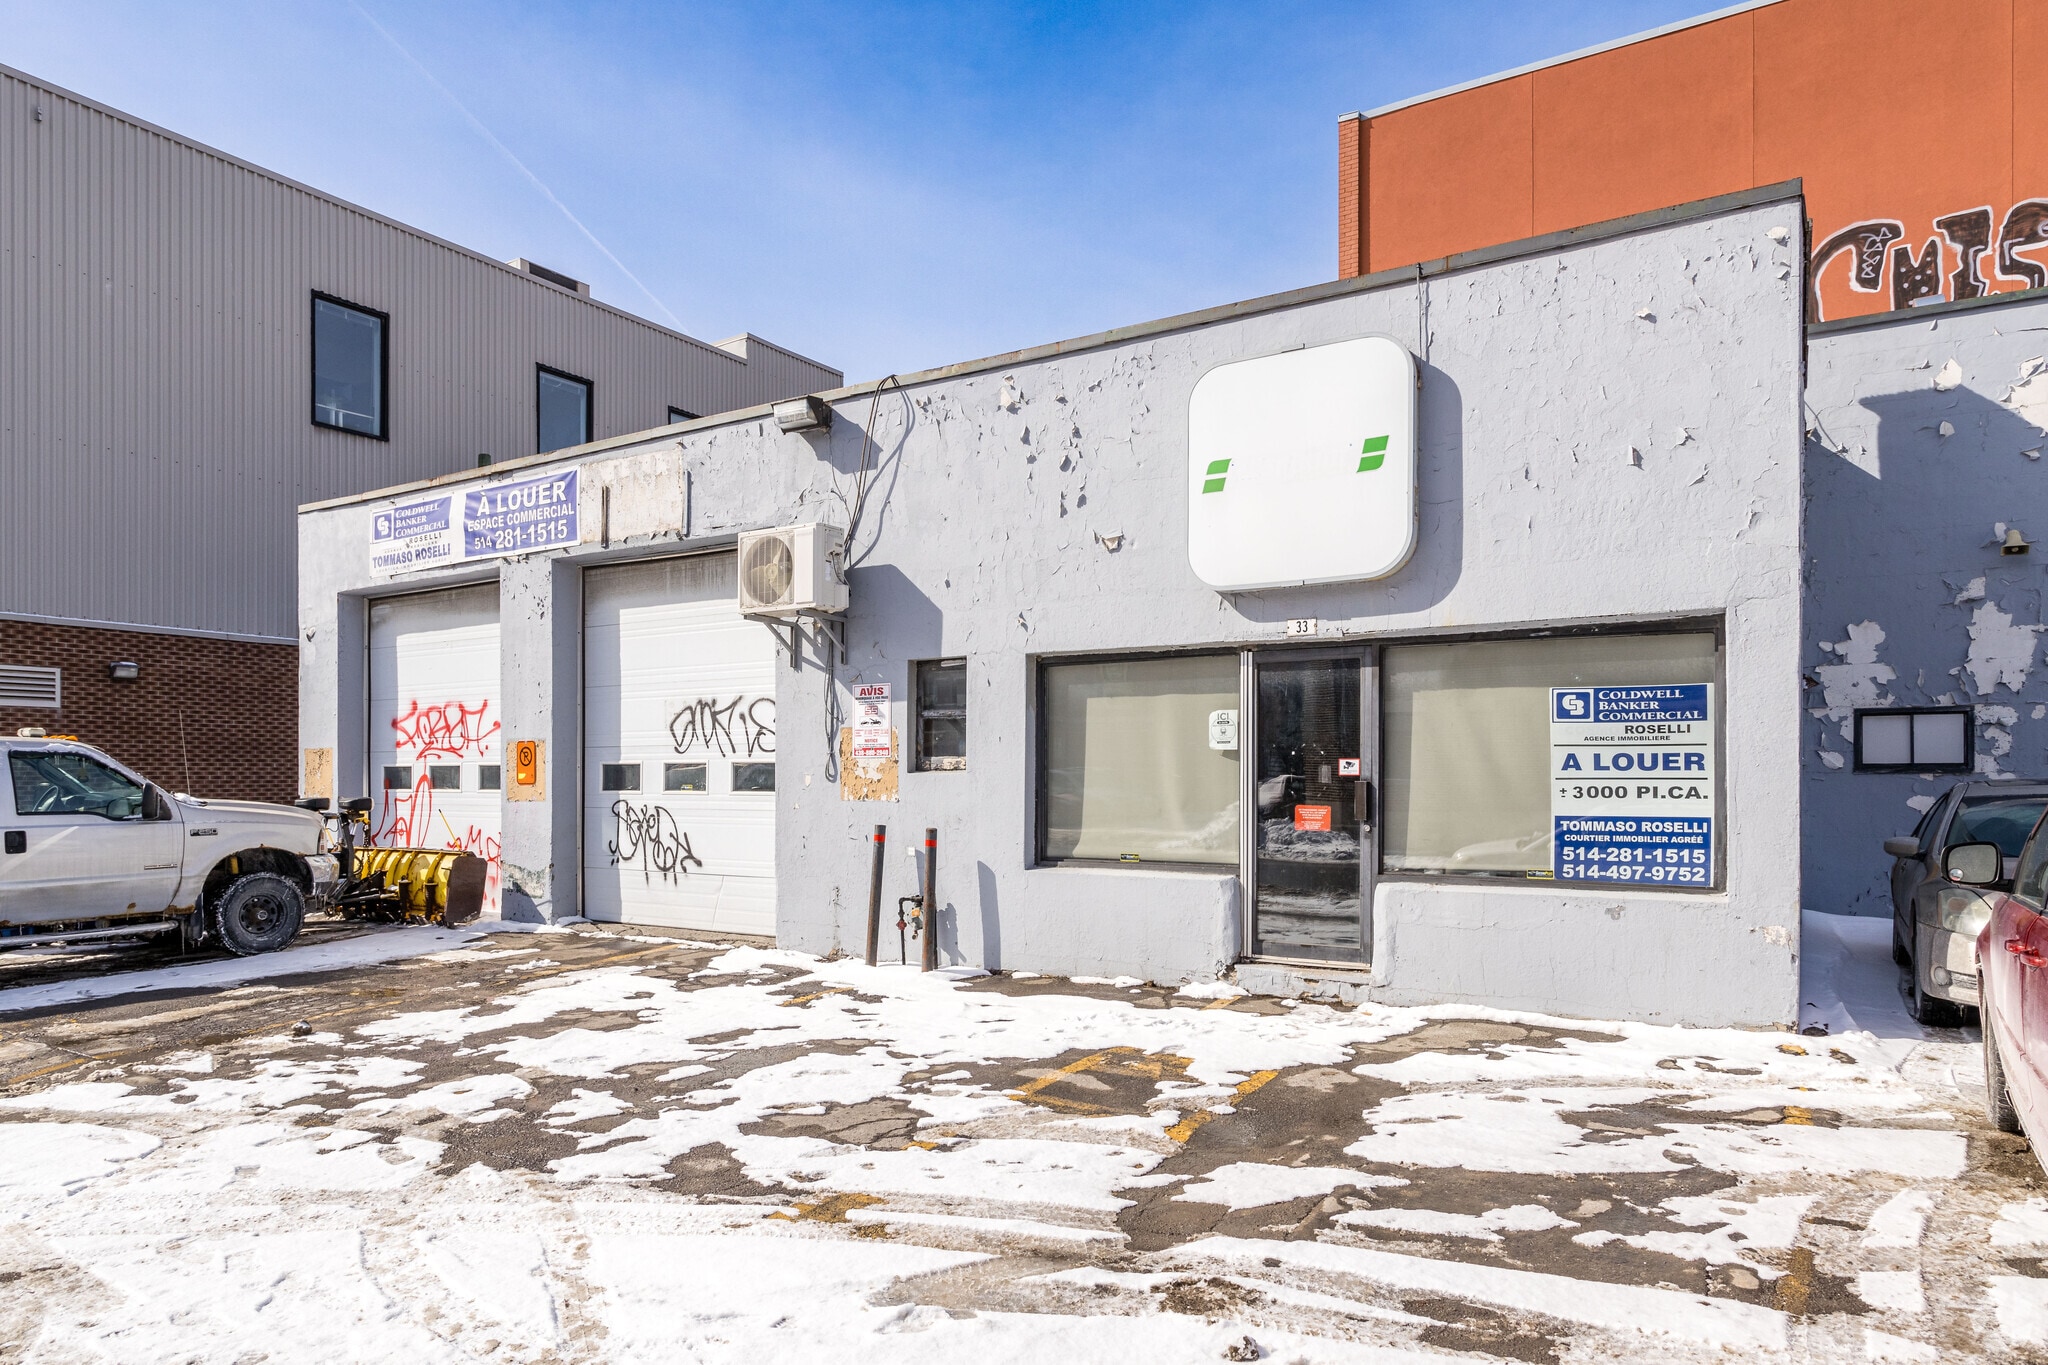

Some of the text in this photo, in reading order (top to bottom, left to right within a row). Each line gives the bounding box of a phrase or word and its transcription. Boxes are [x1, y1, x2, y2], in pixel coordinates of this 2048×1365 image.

[476, 480, 567, 516] À LOUER
[396, 504, 440, 518] COLDWELL
[468, 502, 575, 532] ESPACE COMMERCIAL
[396, 515, 427, 528] BANKER
[396, 520, 447, 538] COMMERCIAL
[474, 520, 568, 550] 514 281-1515
[409, 532, 442, 544] ROSELLI
[372, 551, 413, 568] TOMMASO
[415, 543, 451, 561] ROSELLI
[1296, 620, 1308, 633] 33
[860, 687, 884, 696] AVIS
[1598, 689, 1684, 700] COLDWELL
[1598, 701, 1660, 711] BANKER
[1598, 710, 1703, 721] COMMERCIAL
[1624, 724, 1691, 734] ROSELLI
[1560, 752, 1706, 772] A LOUER
[1572, 785, 1628, 799] 3000
[1636, 785, 1709, 800] PI.CA.
[1560, 820, 1708, 833] TOMMASO ROSELLI
[1564, 834, 1611, 842] COURTIER
[1612, 835, 1669, 843] IMMOBILIER
[1562, 846, 1706, 864] 514-281-1515
[1562, 864, 1706, 882] 514-497-9752
